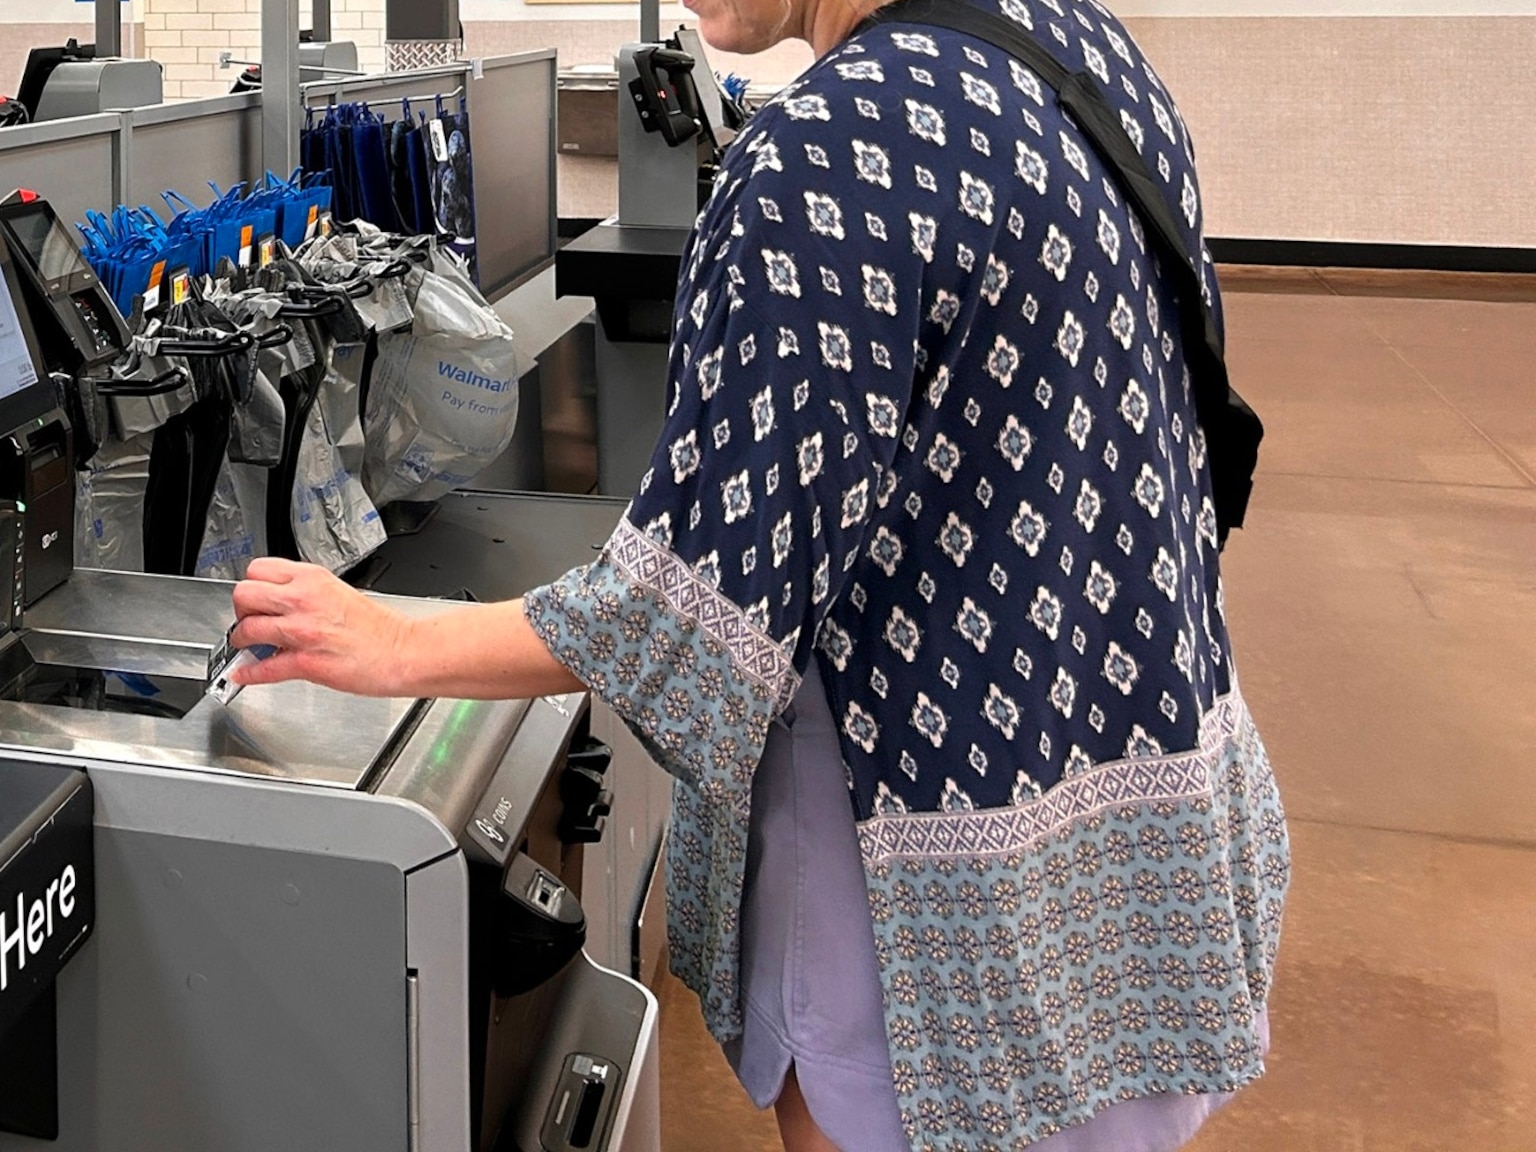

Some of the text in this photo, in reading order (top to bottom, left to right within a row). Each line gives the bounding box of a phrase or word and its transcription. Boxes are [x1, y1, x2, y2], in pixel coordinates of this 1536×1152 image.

[441, 390, 499, 416] Pay from
[492, 797, 513, 825] COINS
